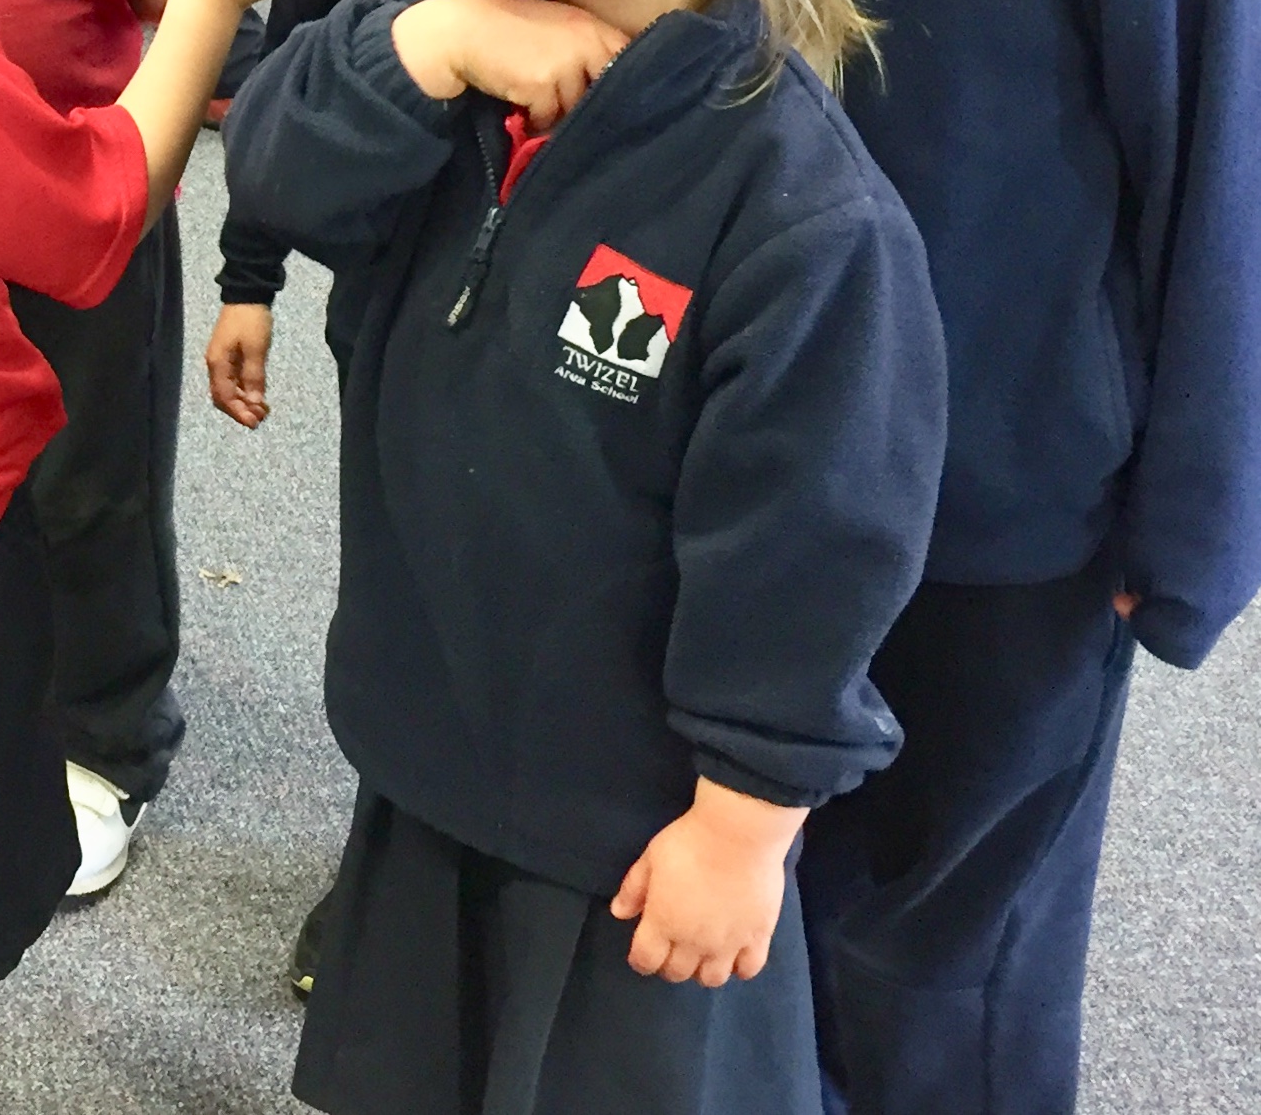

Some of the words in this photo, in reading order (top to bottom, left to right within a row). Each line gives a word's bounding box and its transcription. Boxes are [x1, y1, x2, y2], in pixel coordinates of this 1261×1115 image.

[553, 366, 586, 386] Area
[590, 380, 639, 404] School
[563, 345, 639, 392] TWIZEL
